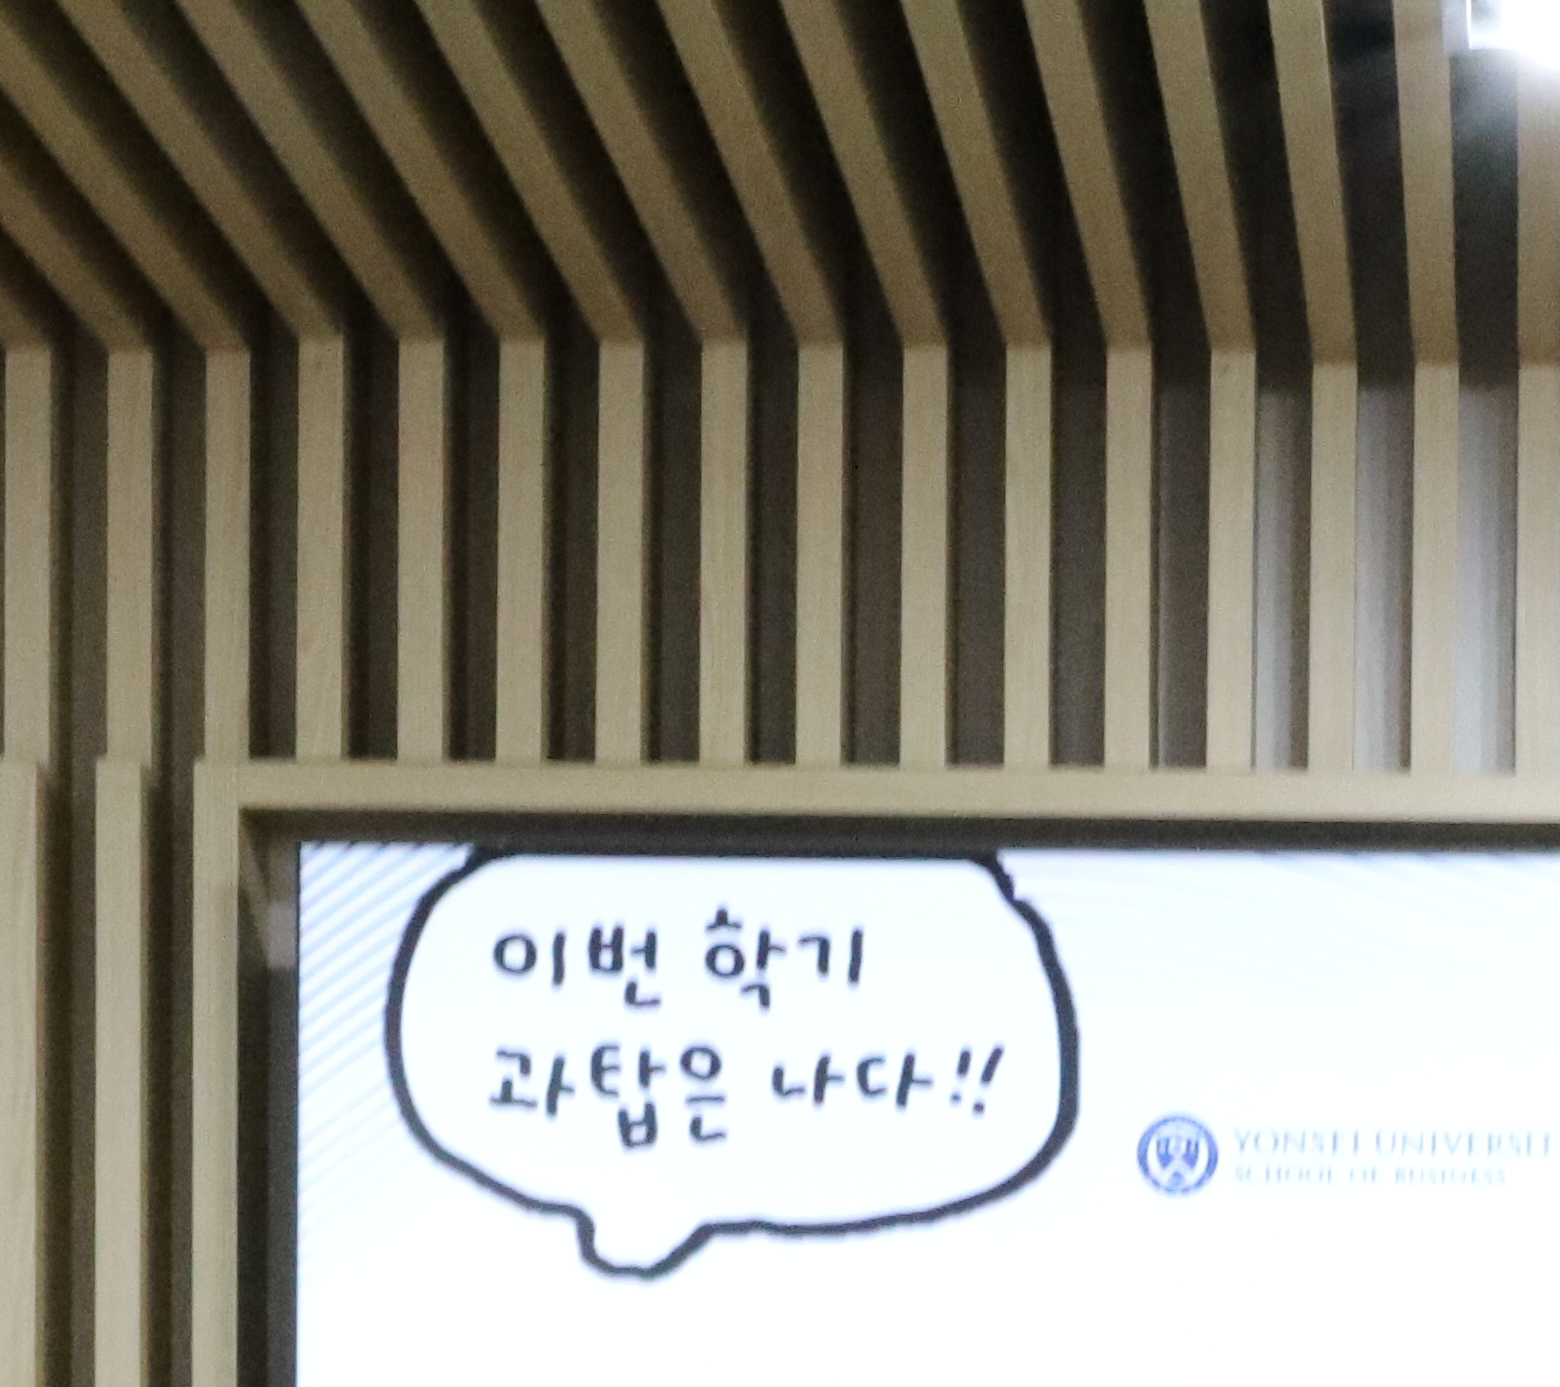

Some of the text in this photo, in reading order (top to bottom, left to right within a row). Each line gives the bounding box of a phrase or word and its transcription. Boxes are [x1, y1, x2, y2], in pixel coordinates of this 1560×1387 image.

[491, 907, 865, 1010] 이번 학기
[489, 1043, 1005, 1150] 과탑은 나다!!
[1233, 1127, 1361, 1157] YONSEI
